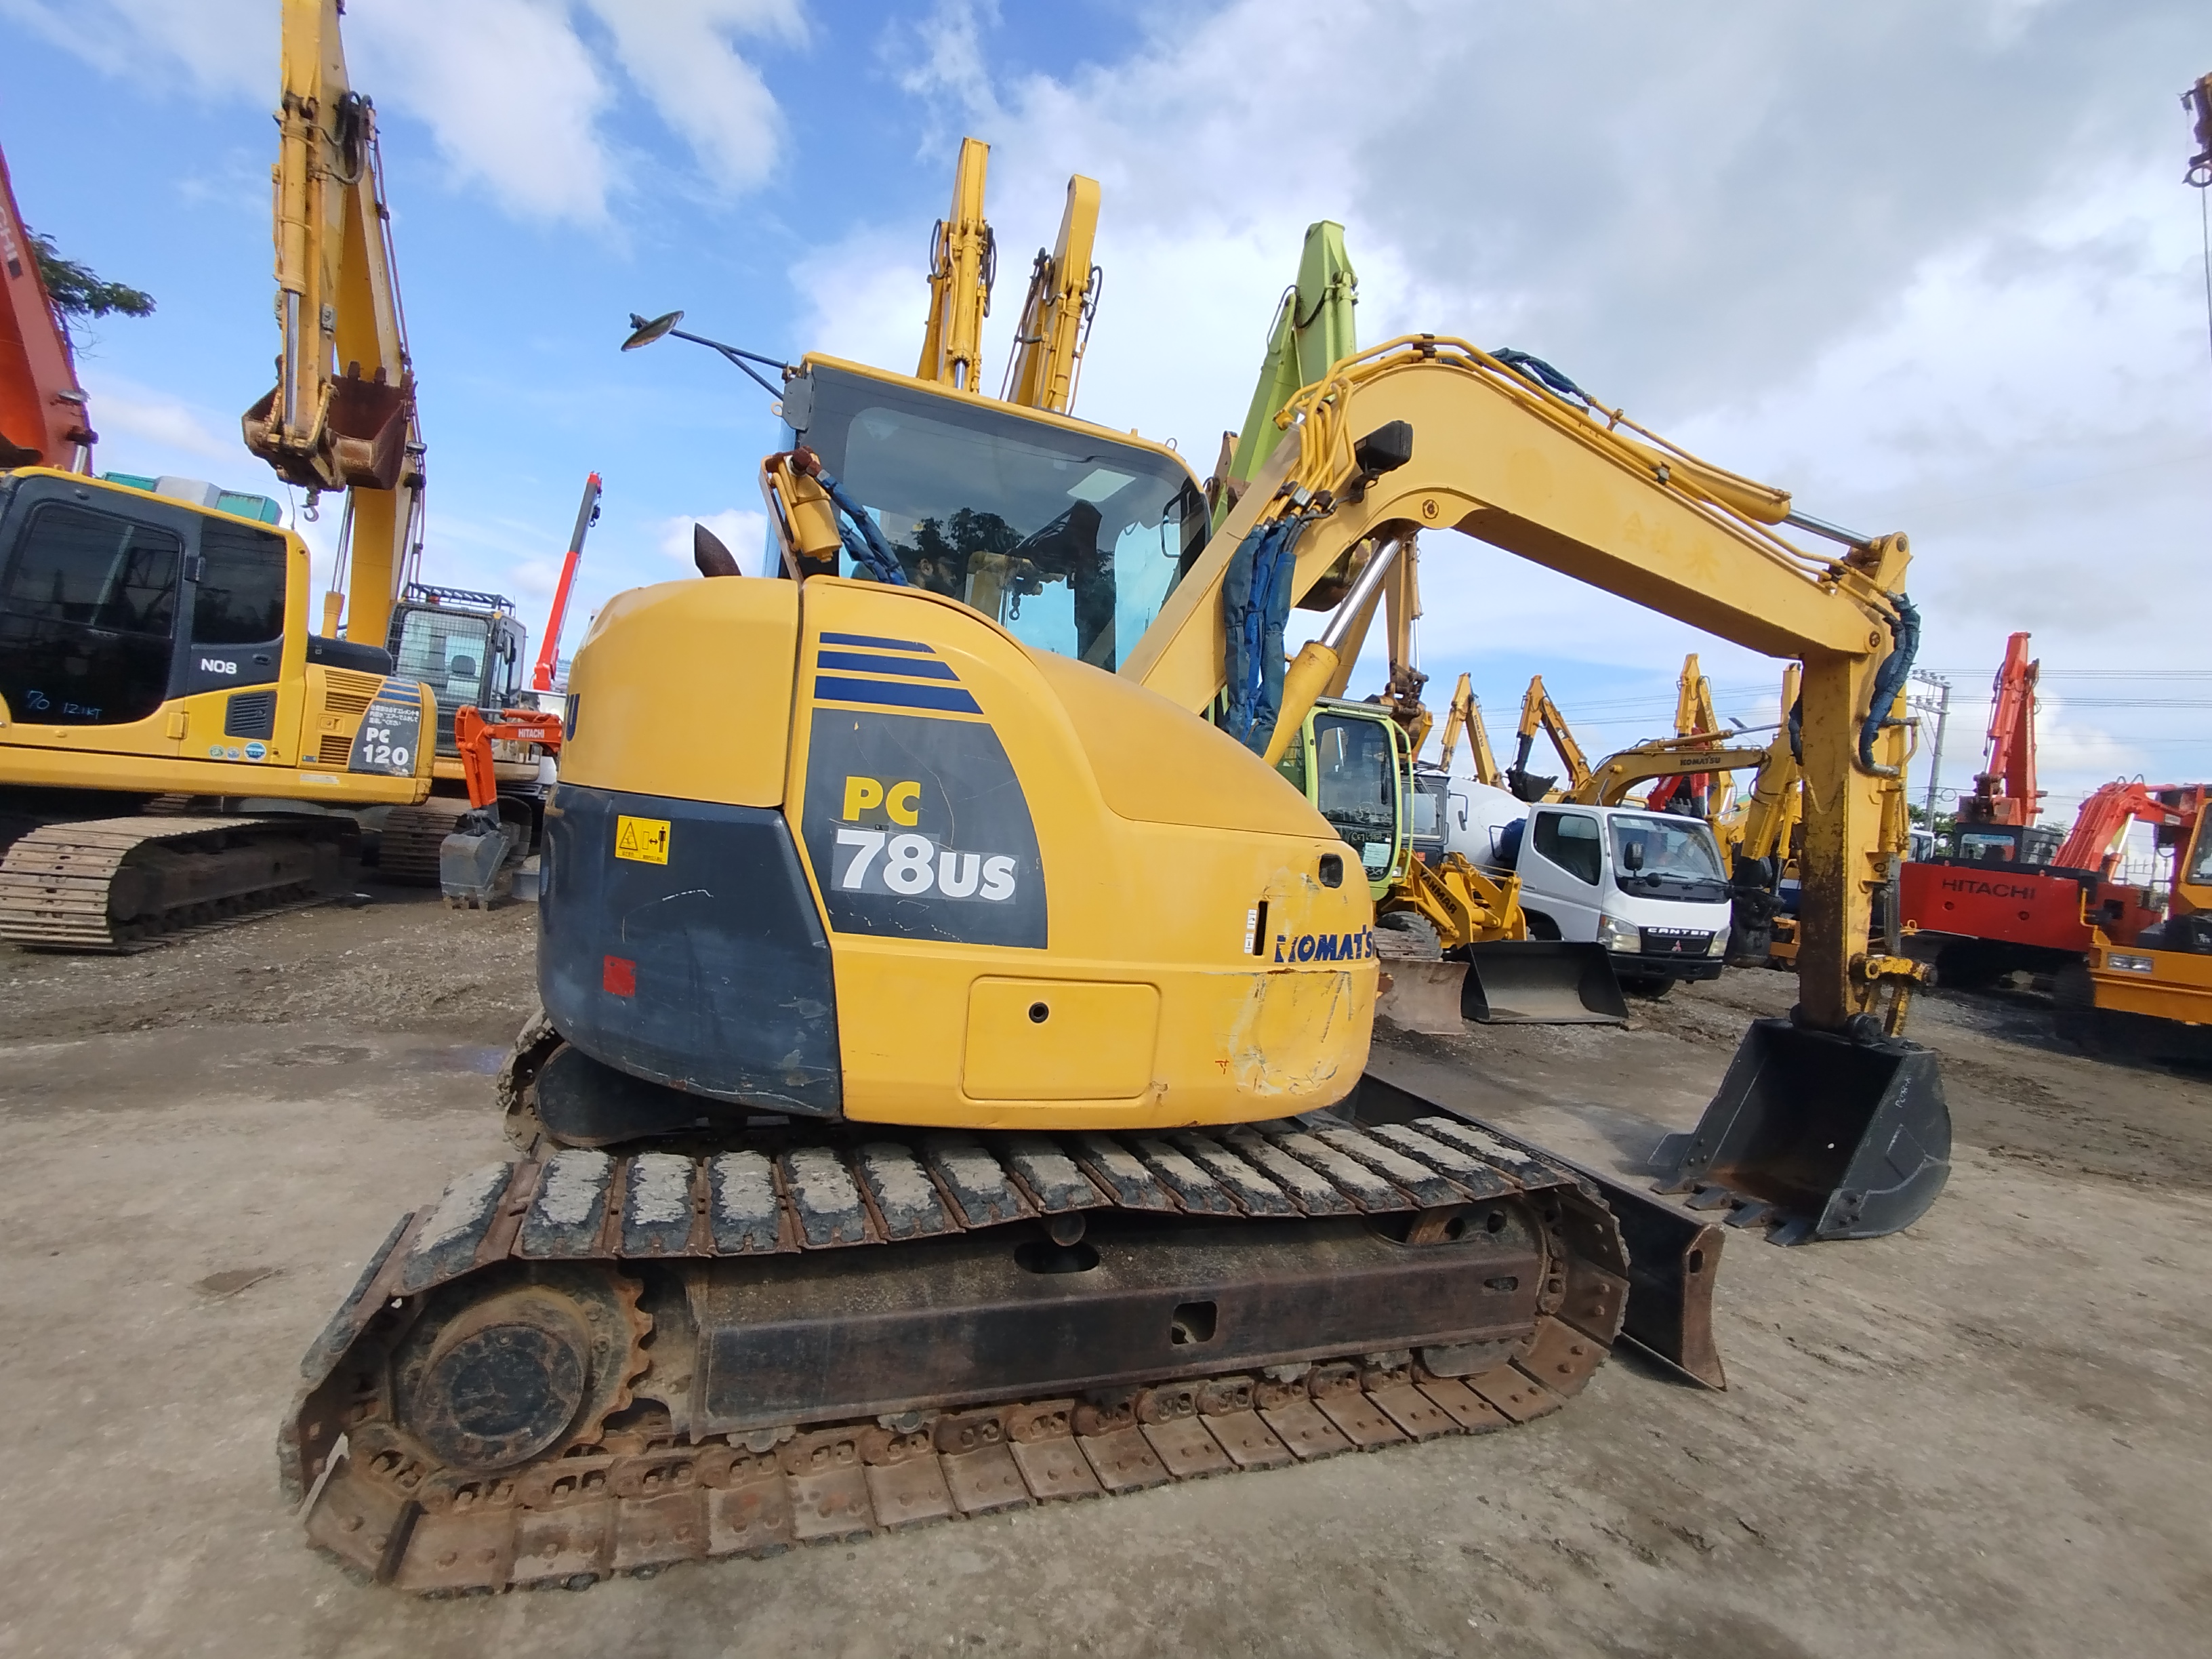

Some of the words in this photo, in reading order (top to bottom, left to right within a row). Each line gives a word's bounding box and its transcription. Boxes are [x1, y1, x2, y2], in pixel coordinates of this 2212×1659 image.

[366, 727, 390, 743] PC
[518, 728, 545, 738] HITACHI
[1474, 714, 1484, 747] KOMATSU
[363, 744, 409, 765] 120
[1680, 756, 1721, 766] KOMATSU
[842, 776, 921, 826] PC
[1420, 867, 1457, 914] YANMAR
[1942, 879, 2036, 899] HITACHI
[1647, 928, 1709, 936] CANTER
[1274, 924, 1374, 962] KOMATS
